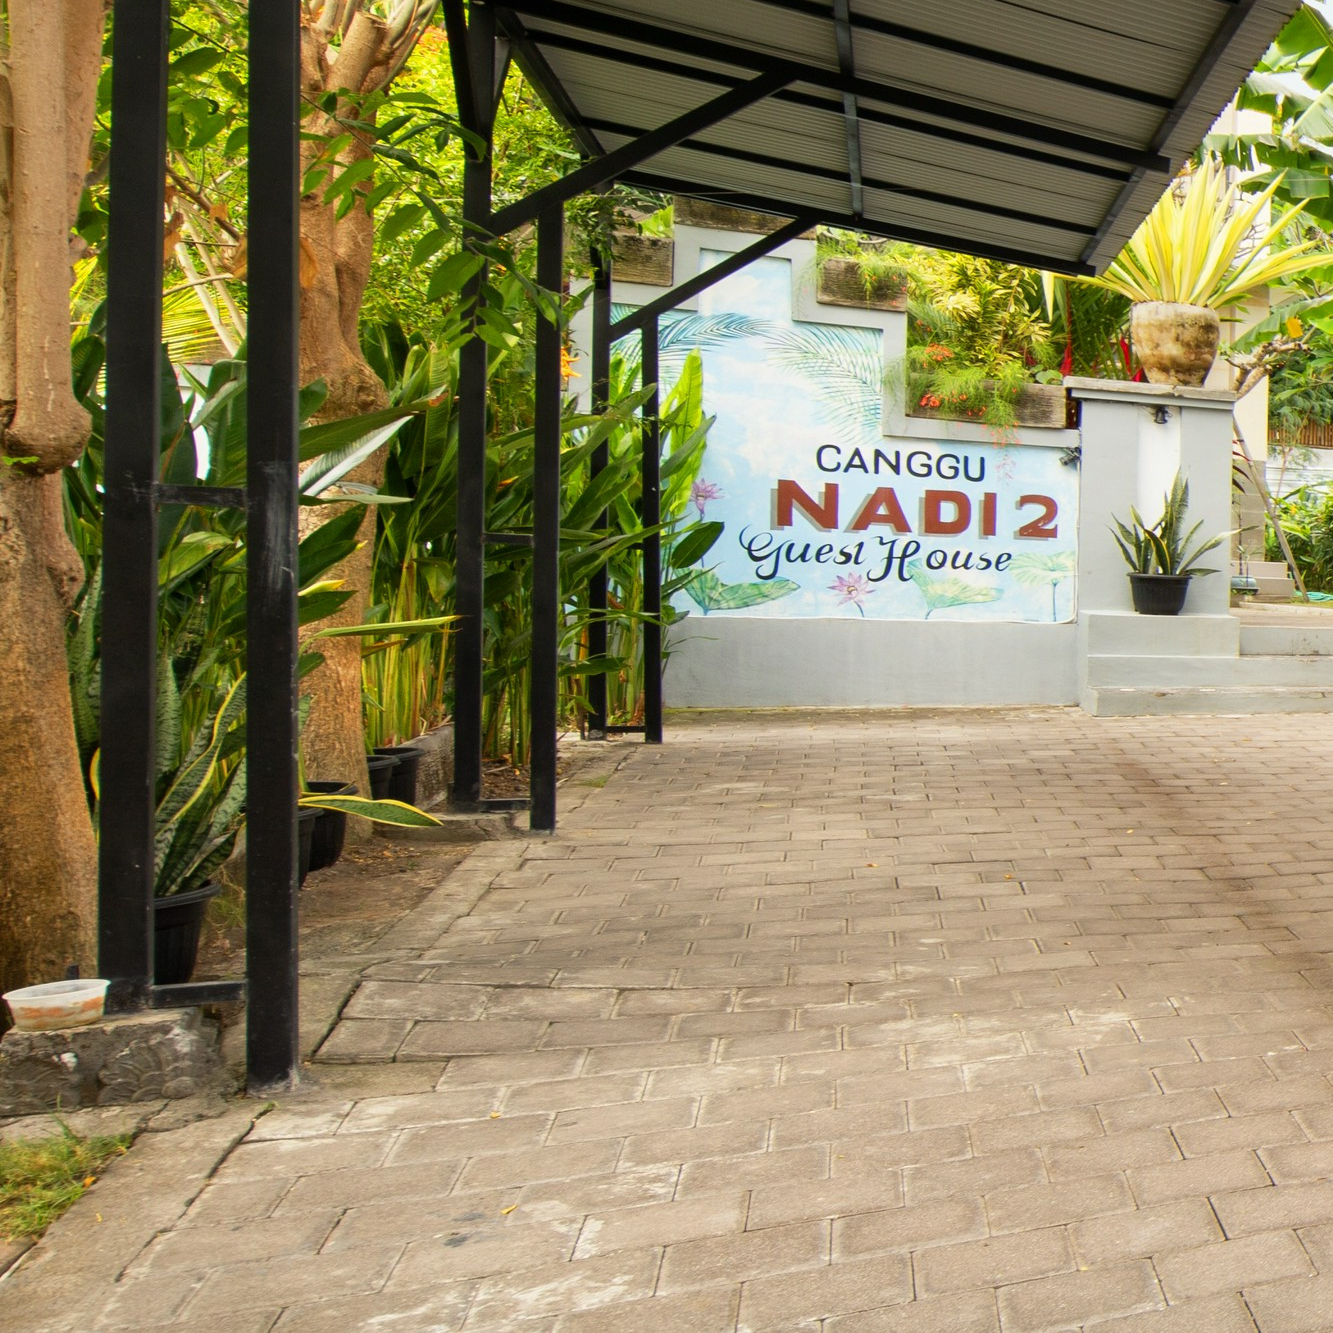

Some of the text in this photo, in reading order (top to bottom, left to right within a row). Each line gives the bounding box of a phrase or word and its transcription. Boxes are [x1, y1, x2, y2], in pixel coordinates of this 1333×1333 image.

[815, 443, 986, 483] CANGGU
[771, 478, 1060, 540] NADI 2
[738, 523, 1013, 583] Guest House
